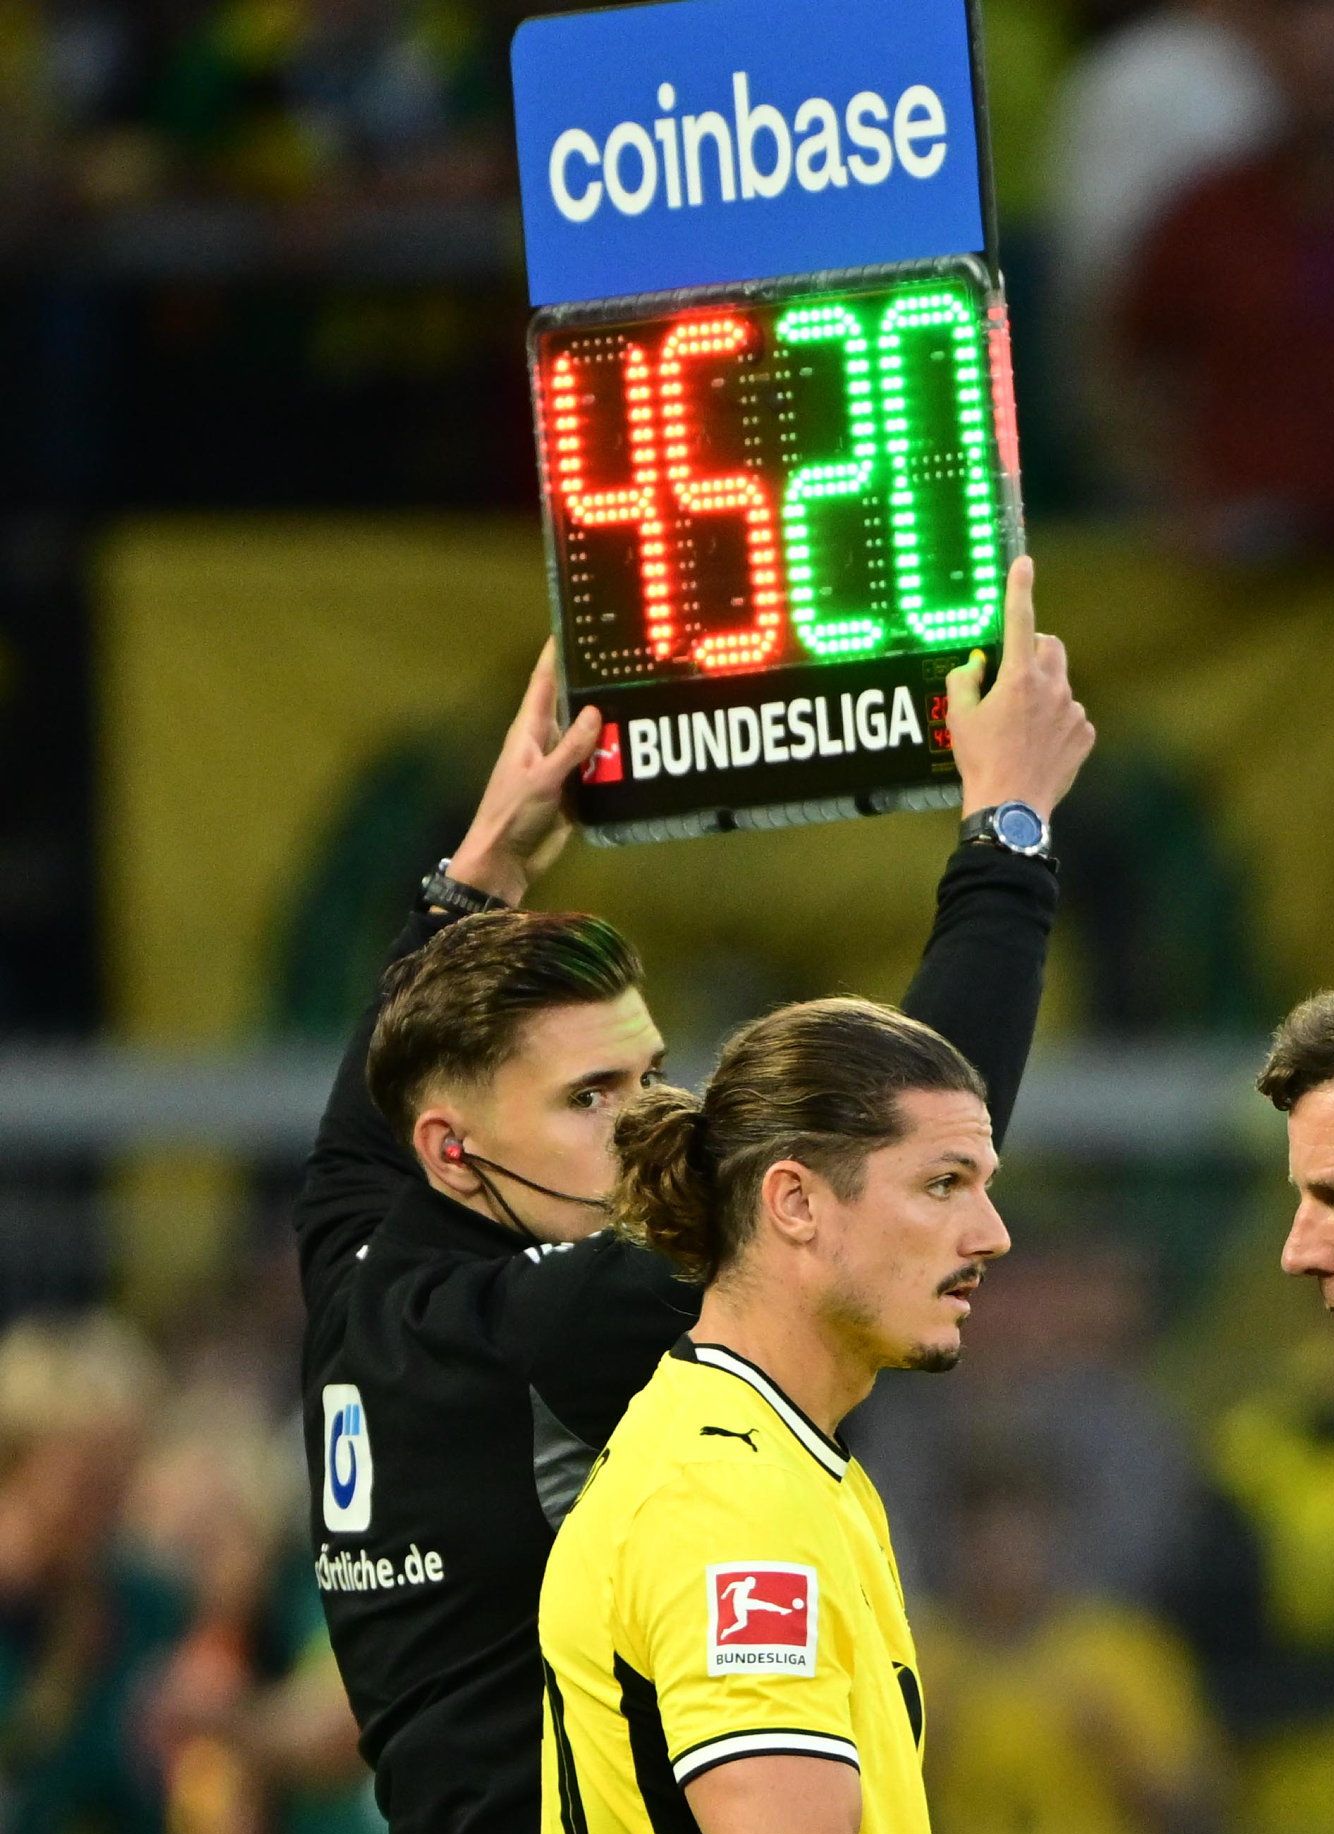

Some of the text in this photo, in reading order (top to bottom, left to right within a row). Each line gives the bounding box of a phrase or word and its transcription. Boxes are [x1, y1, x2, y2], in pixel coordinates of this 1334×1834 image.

[549, 71, 947, 221] coinbase
[552, 293, 998, 669] 45 20
[627, 686, 924, 780] BUNDESLIGA
[715, 1652, 808, 1667] BUNDESLIGA
